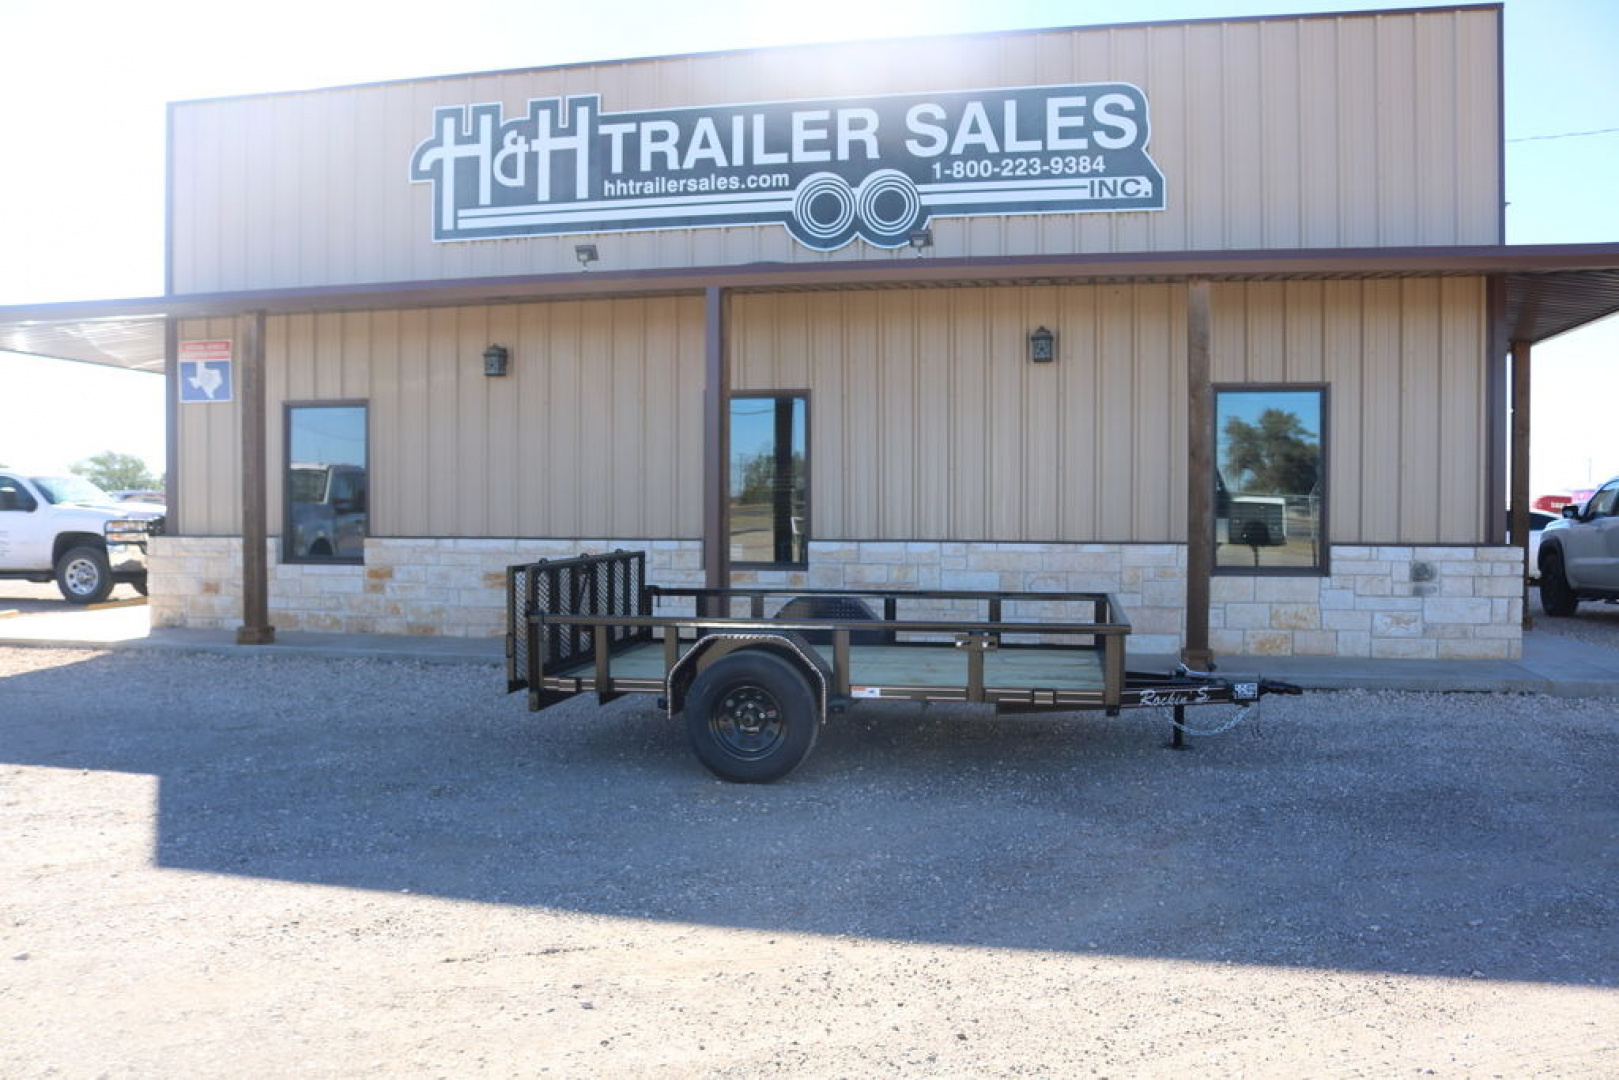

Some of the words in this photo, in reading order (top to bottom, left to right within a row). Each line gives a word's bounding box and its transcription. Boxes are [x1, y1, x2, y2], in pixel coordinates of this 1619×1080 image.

[419, 106, 589, 230] H&H
[599, 110, 880, 174] TRAILER
[906, 93, 1138, 157] SALES
[932, 155, 1106, 179] 1-800-223-9384
[603, 173, 790, 197] hhtrailersales.com
[1088, 178, 1150, 198] INC.
